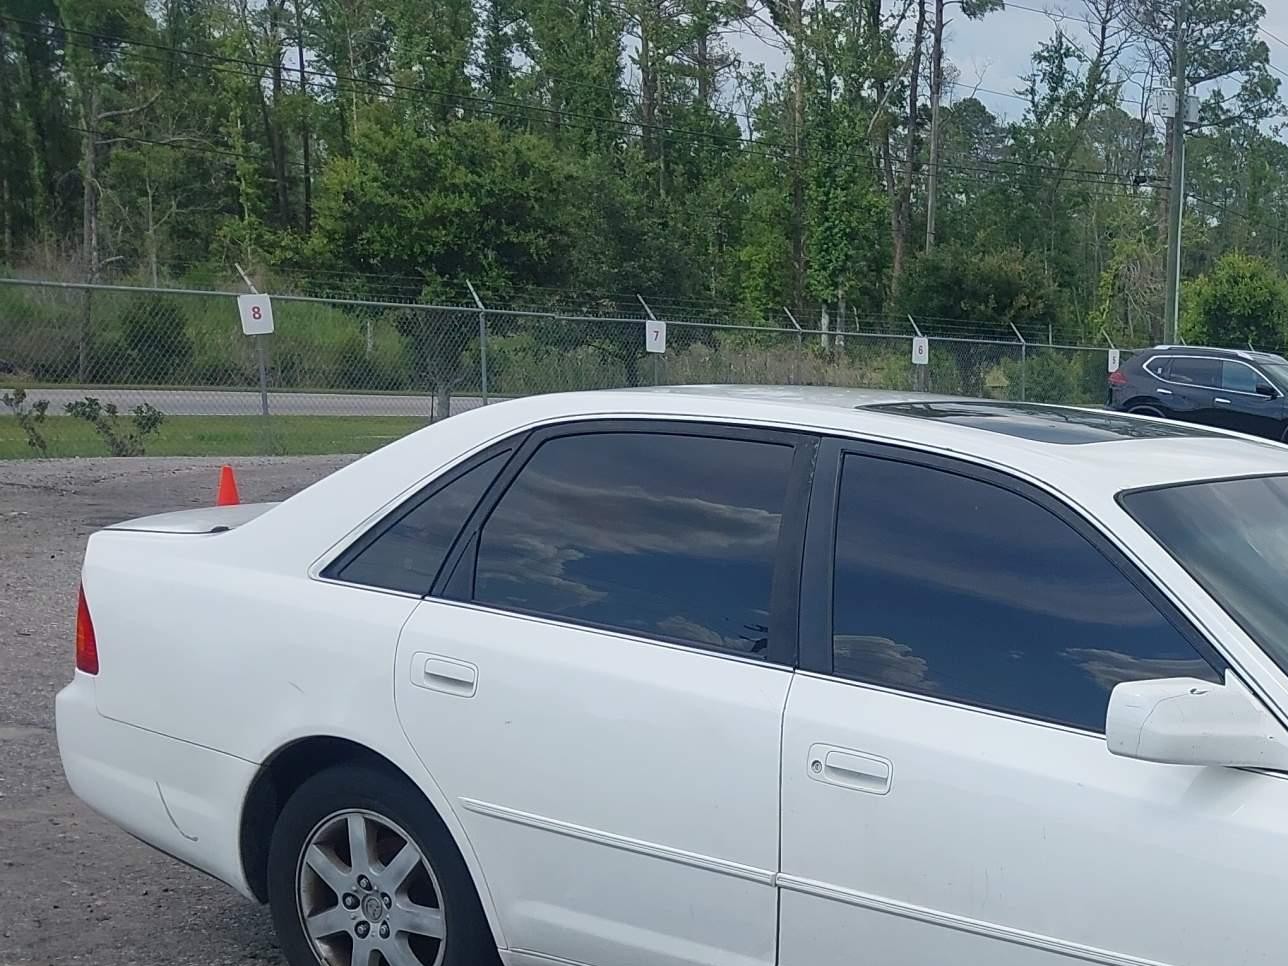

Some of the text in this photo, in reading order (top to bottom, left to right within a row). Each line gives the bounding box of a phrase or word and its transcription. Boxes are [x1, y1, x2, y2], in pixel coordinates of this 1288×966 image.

[252, 306, 262, 320] 8
[653, 330, 659, 341] 7
[918, 345, 924, 355] 6
